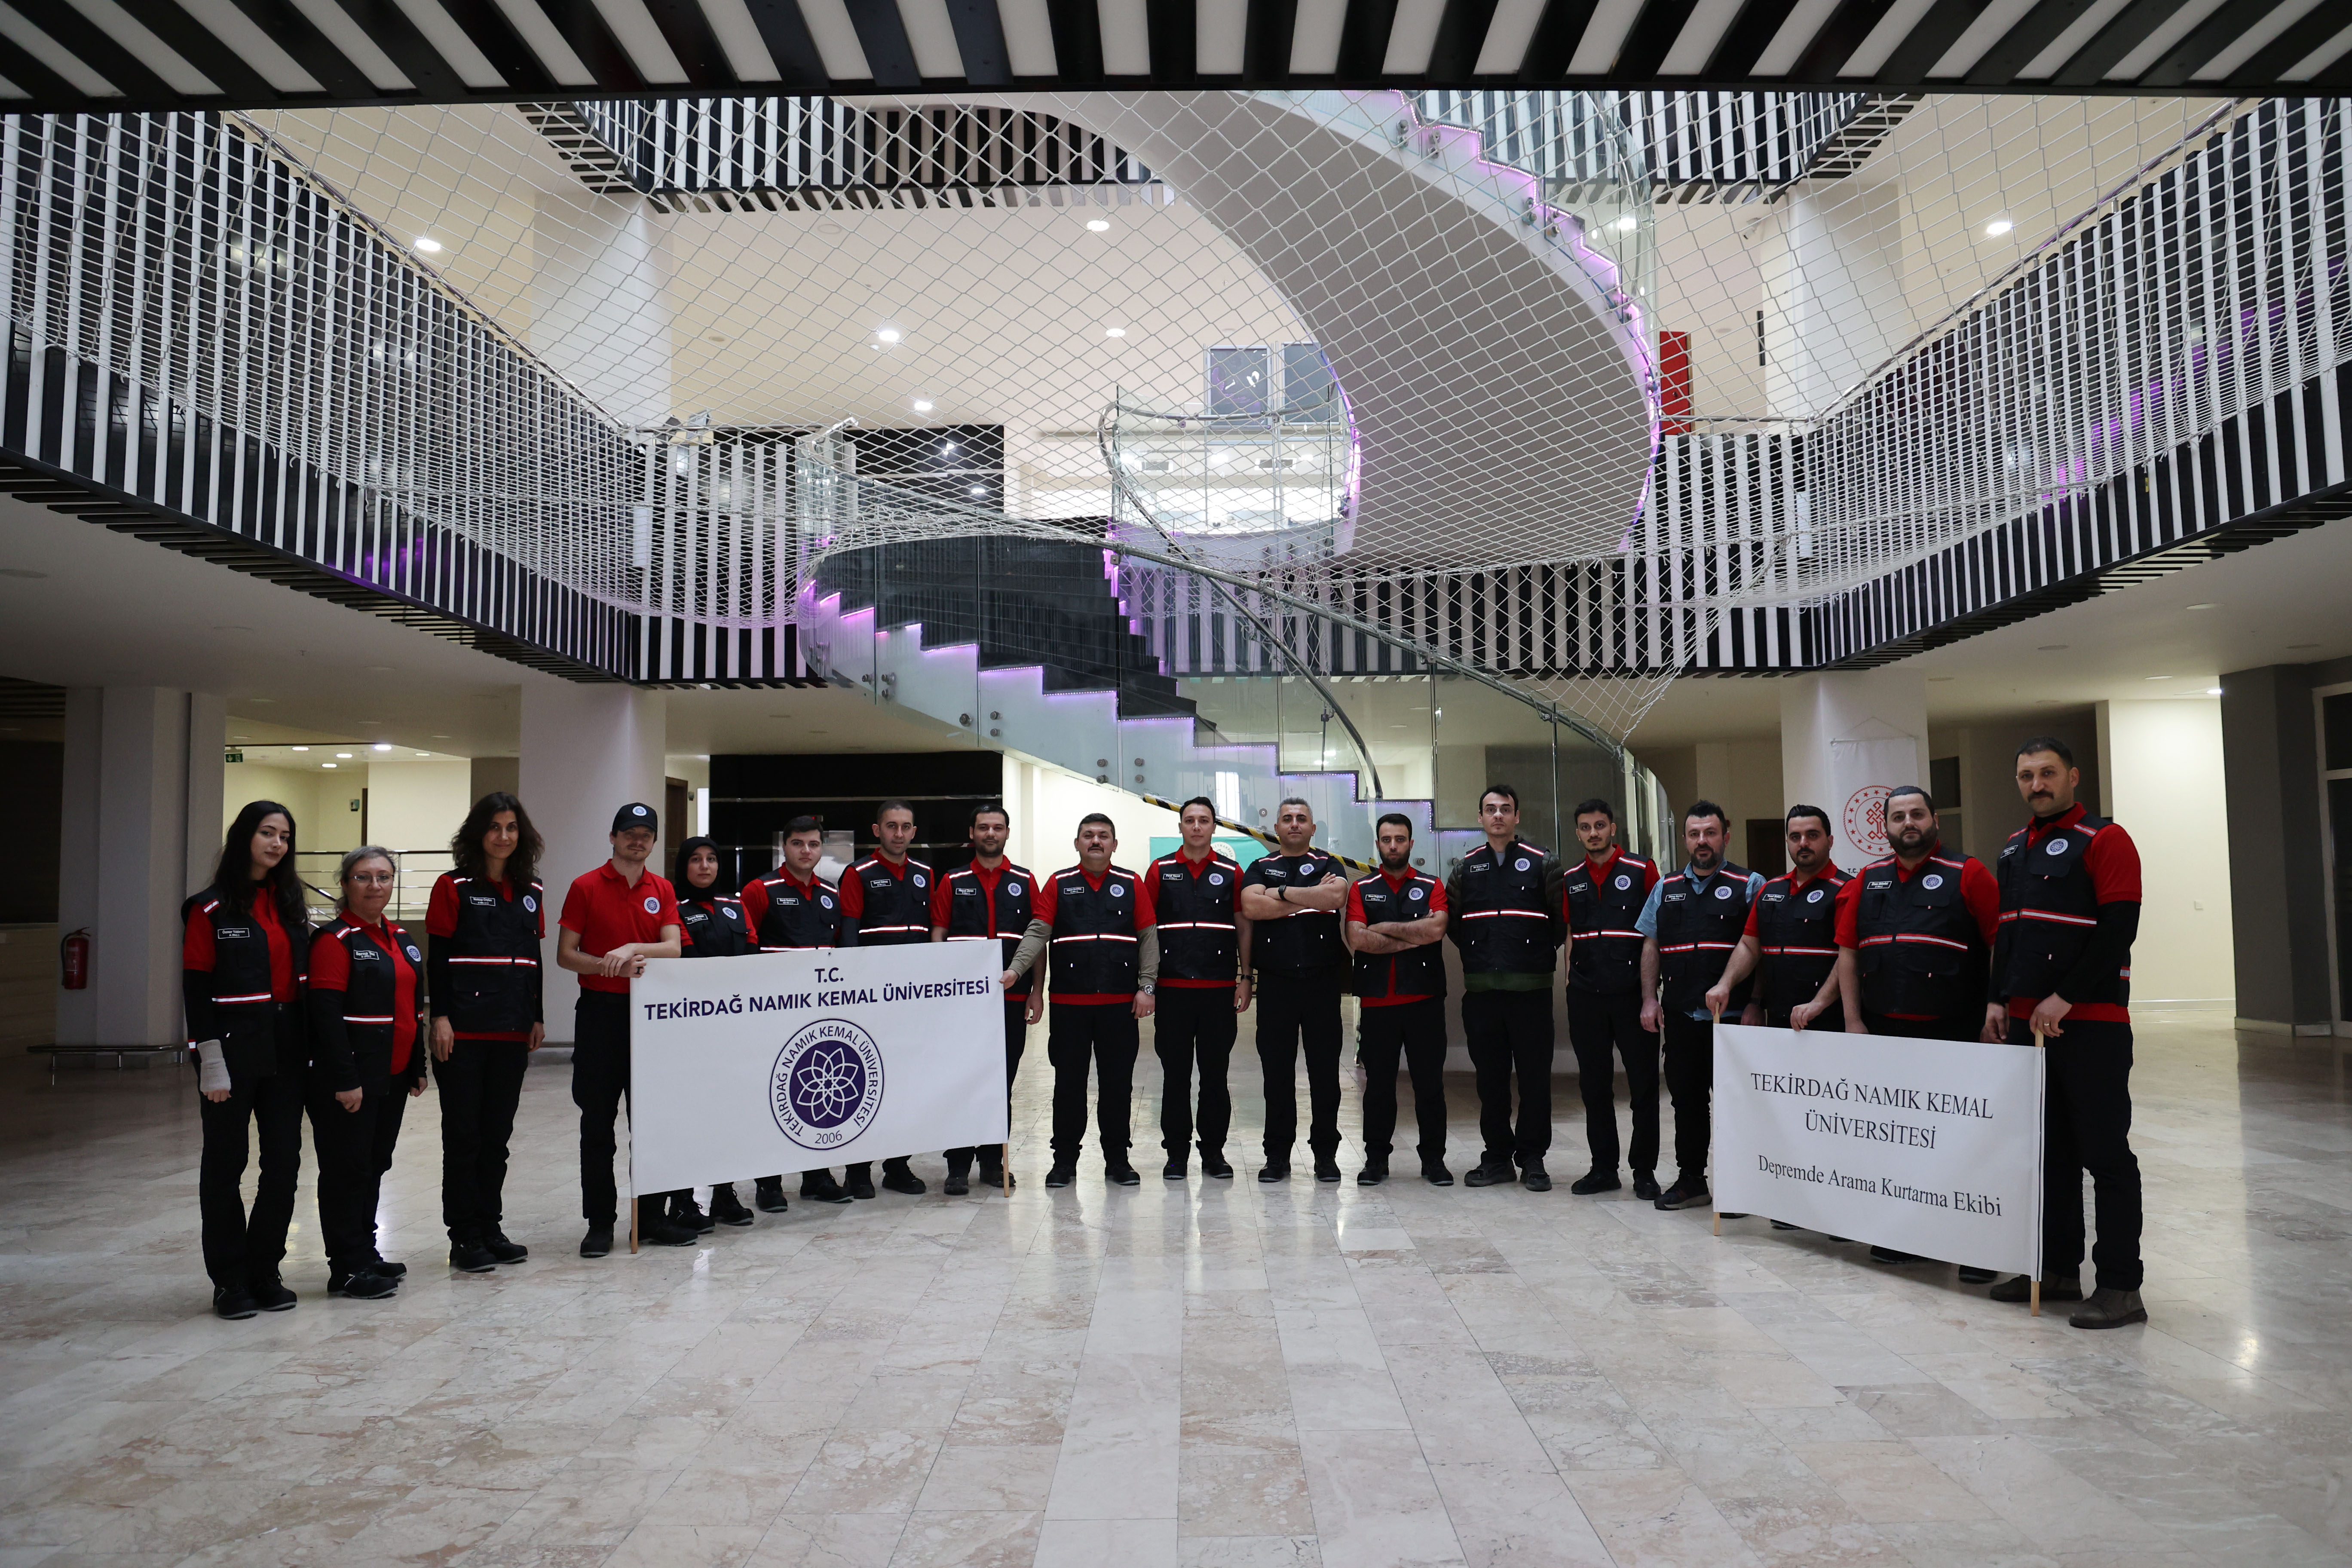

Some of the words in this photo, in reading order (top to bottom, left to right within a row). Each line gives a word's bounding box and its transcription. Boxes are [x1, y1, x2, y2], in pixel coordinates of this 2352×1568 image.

[814, 967, 844, 983] T.C.
[644, 994, 742, 1020] TEKİRDAĞ
[750, 993, 812, 1012] NAMIK
[818, 988, 878, 1007] KEMAL
[883, 976, 989, 1002] ÜNİVERSİTESİ
[781, 1029, 818, 1069] NAMIK
[819, 1026, 859, 1045] KEMAL
[775, 1072, 804, 1137] TEKİRDAĞ
[853, 1040, 878, 1128] ÜNİVERSİTESİ
[1750, 1072, 1849, 1100] TEKİRDAĞ
[1854, 1084, 1921, 1110] NAMIK
[1926, 1092, 1993, 1119] KEMAL
[814, 1130, 842, 1144] 2006
[1805, 1109, 1936, 1149] ÜNİVERSİTESİ
[1758, 1155, 1824, 1184] Depremde
[1827, 1169, 1876, 1194] Arama
[1880, 1177, 1948, 1208] Kurtarma
[1953, 1191, 2002, 1217] Ekibi
